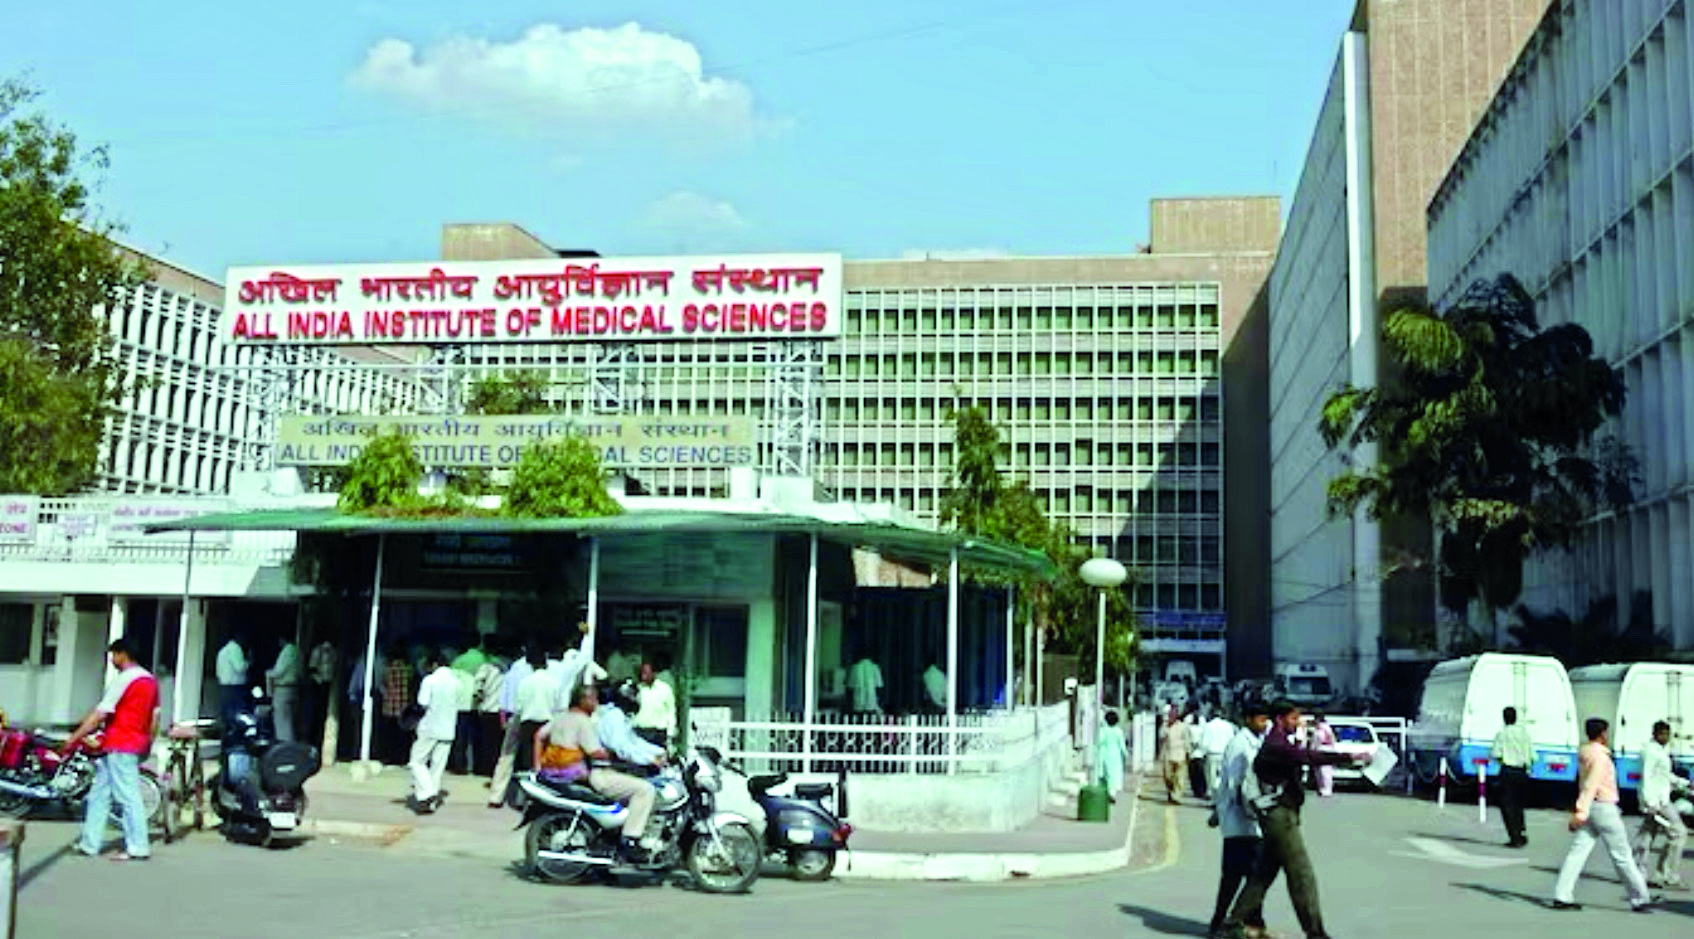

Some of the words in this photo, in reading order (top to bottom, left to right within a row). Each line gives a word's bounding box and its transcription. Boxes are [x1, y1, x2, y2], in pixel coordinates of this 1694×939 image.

[238, 271, 342, 303] अखिल
[361, 267, 479, 302] भारतीय
[494, 263, 674, 306] आयुर्विज्ञान
[691, 263, 824, 298] संस्थान
[232, 311, 279, 341] ALL
[287, 310, 354, 340] INDIA
[364, 308, 497, 339] INSTITUTE
[505, 307, 542, 337] OF
[551, 304, 675, 336] MEDICAL
[681, 302, 828, 334] SCIENCES
[281, 444, 321, 461] ALL
[327, 444, 370, 461] IND
[412, 444, 491, 462] STITUTE
[639, 445, 753, 463] SCIENCES
